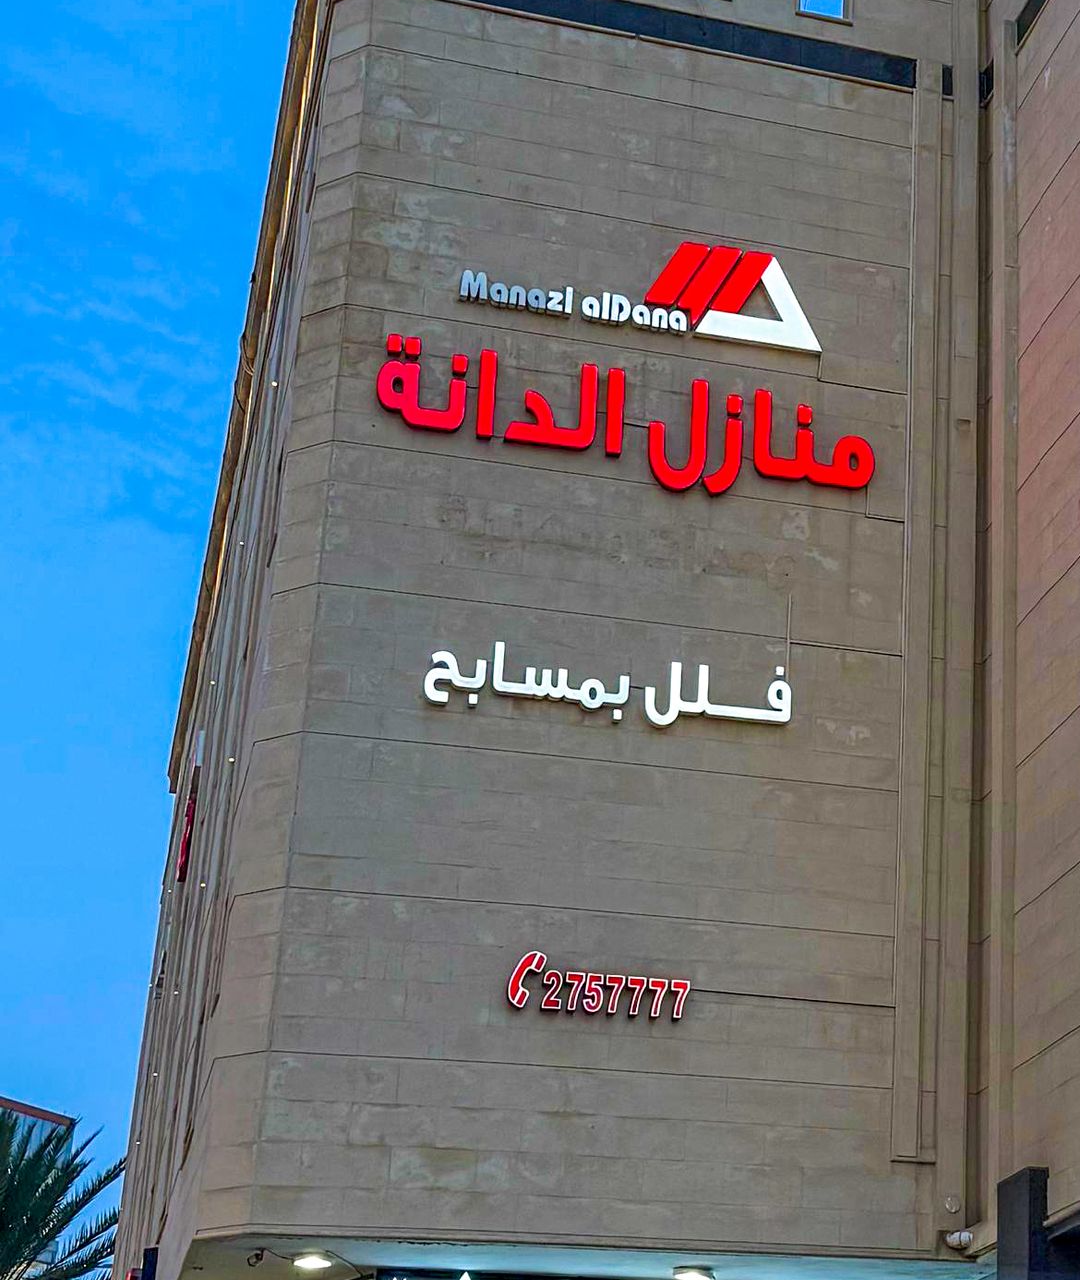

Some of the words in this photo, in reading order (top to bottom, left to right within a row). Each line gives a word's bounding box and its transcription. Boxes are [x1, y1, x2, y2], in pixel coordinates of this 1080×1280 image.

[460, 269, 574, 314] Manazl
[581, 291, 688, 332] alDana
[376, 333, 626, 456] الدانة
[648, 379, 876, 495] منازل
[423, 642, 631, 721] بمسابح
[541, 970, 691, 1018] 2757777
